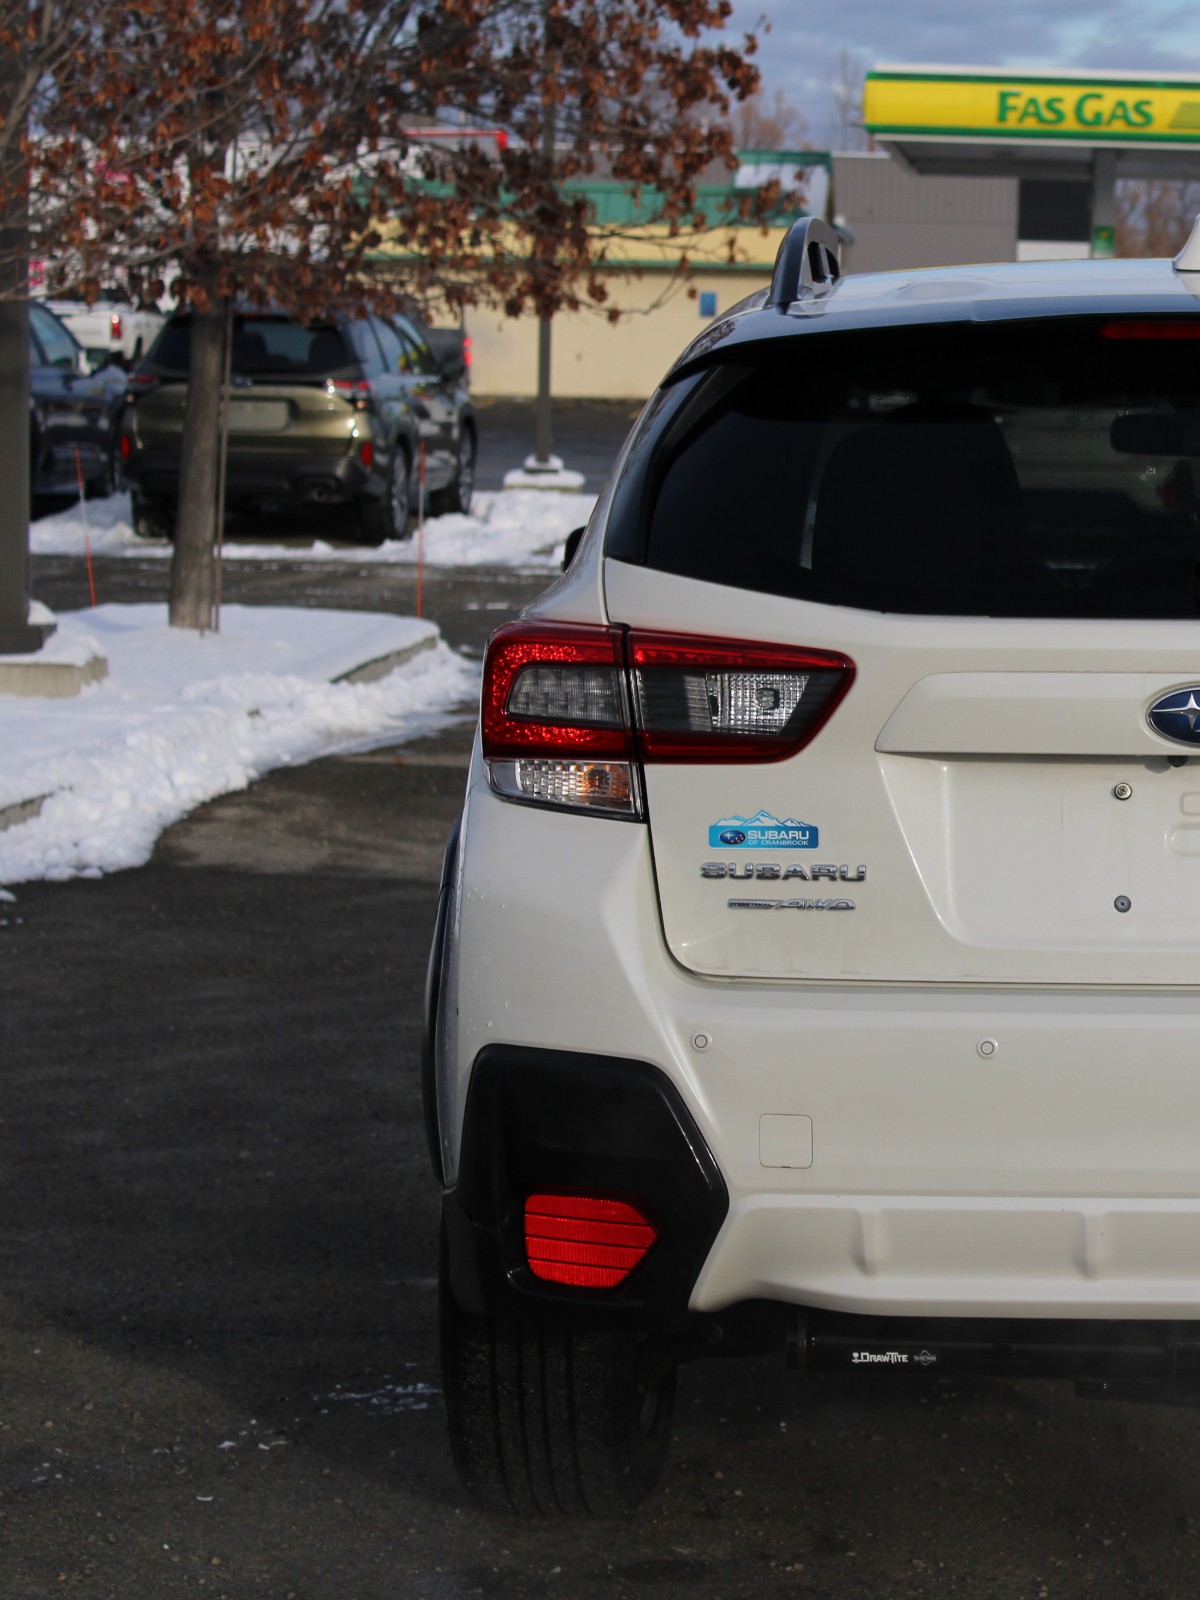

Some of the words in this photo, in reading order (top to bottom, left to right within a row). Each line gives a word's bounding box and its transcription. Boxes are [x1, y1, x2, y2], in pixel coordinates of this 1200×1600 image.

[997, 90, 1067, 125] FAS
[1074, 92, 1155, 128] GAS
[747, 830, 810, 840] SUBARU
[701, 862, 867, 882] SUBARU
[776, 898, 856, 911] AWD
